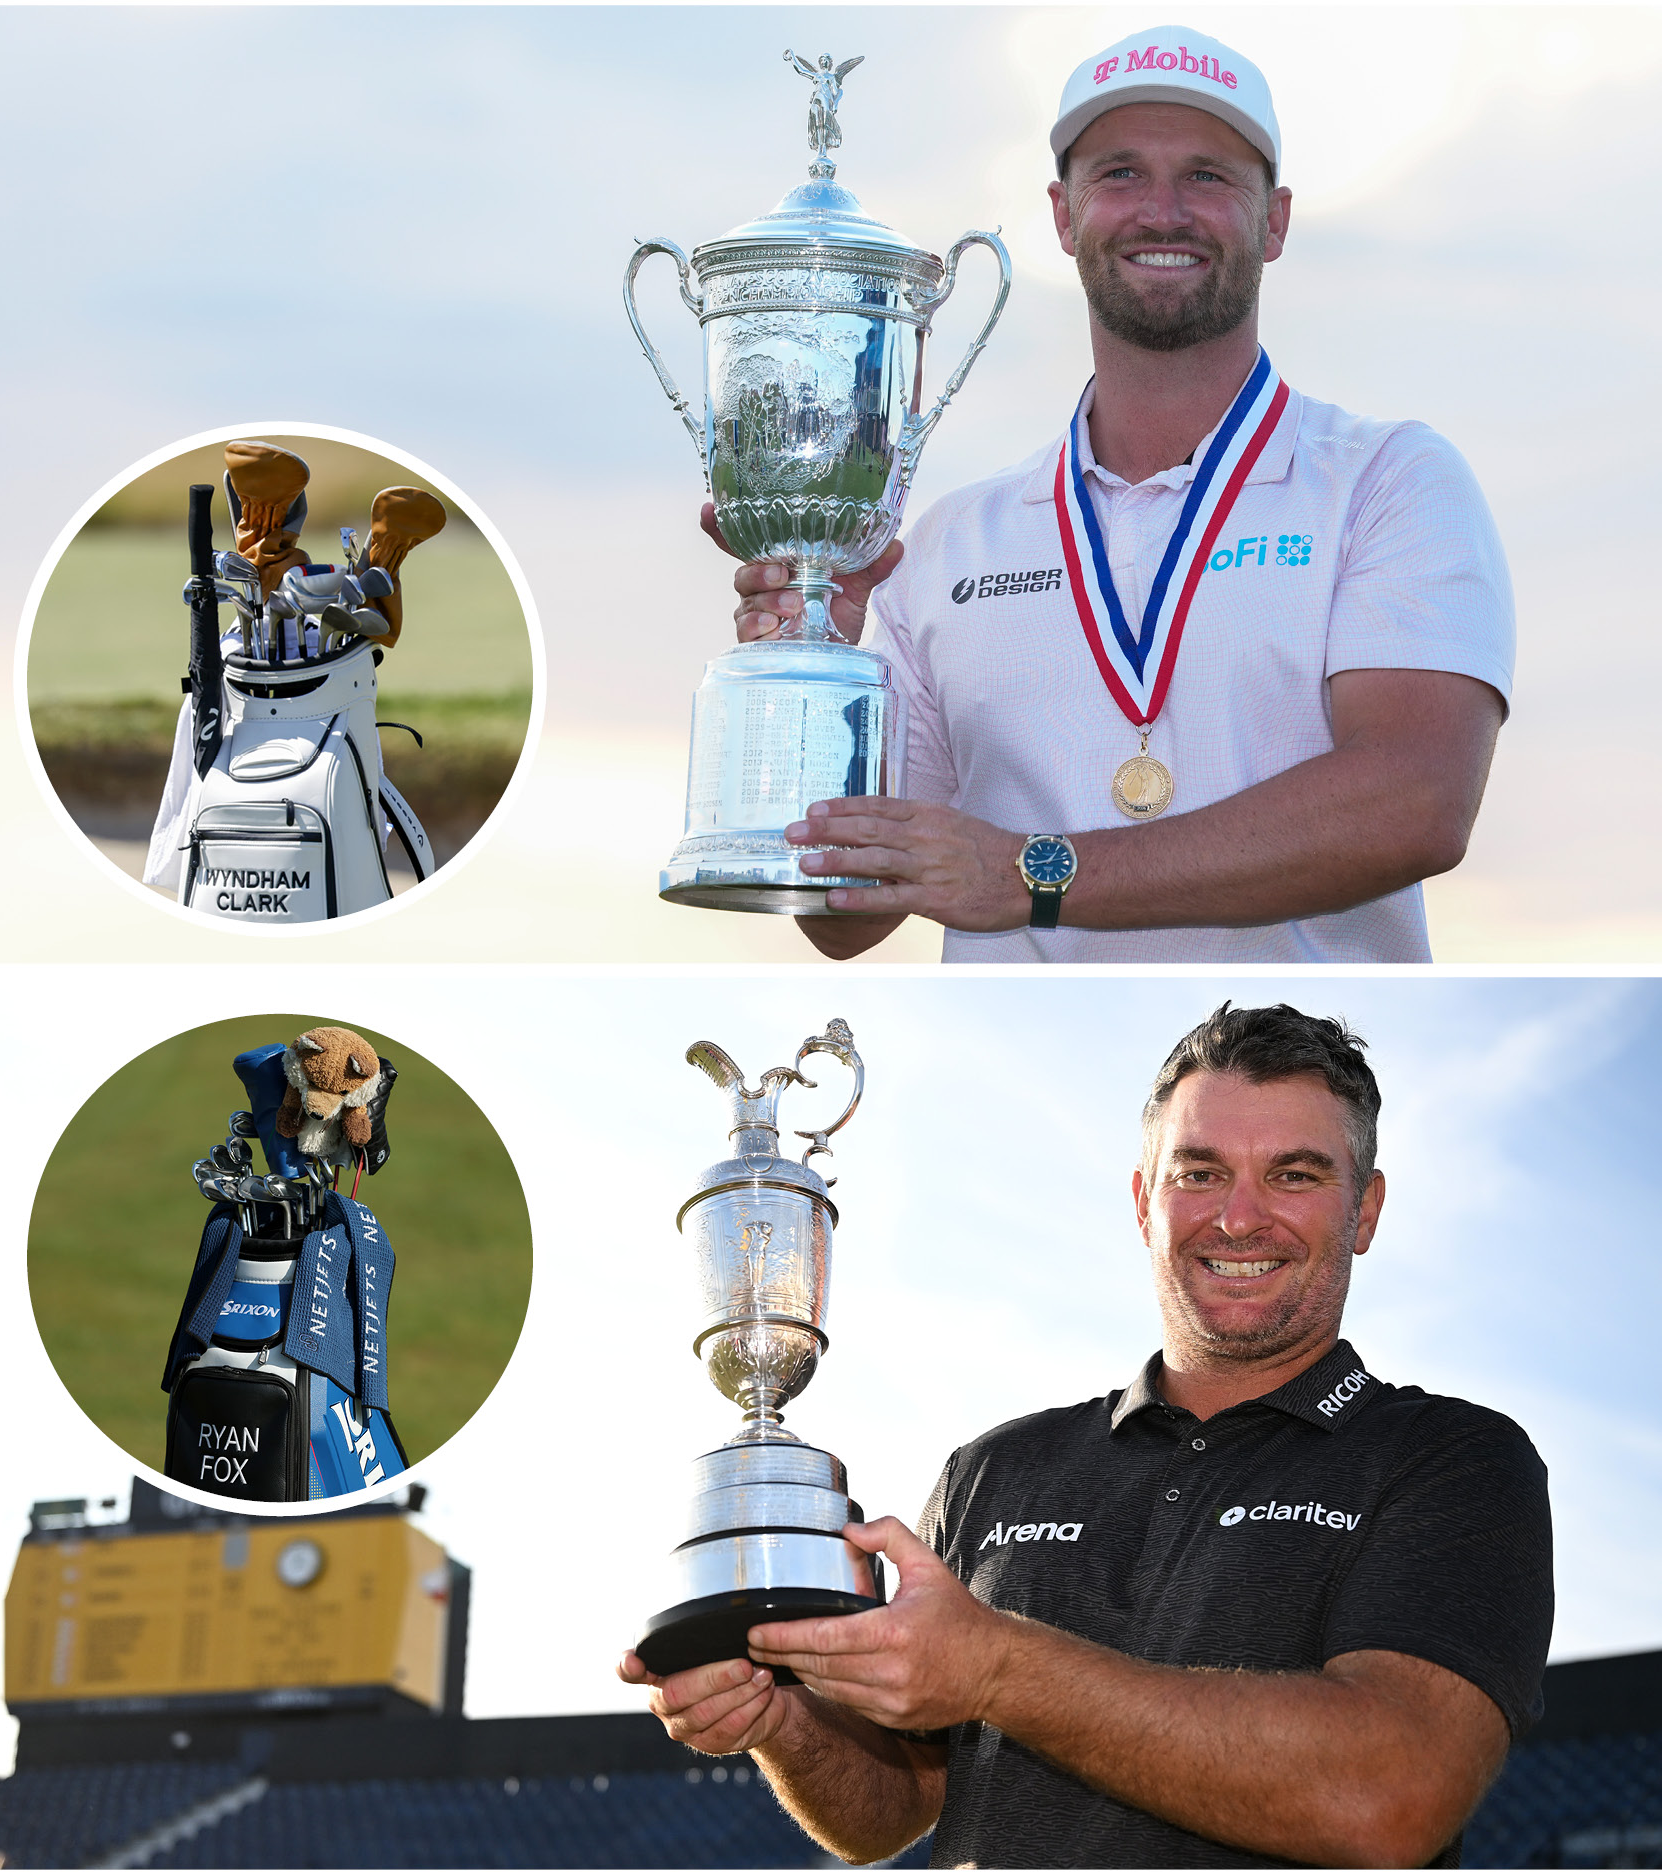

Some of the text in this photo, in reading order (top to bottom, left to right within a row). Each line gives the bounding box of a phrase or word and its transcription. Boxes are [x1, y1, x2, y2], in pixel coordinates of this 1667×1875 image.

[1124, 46, 1238, 90] Mobile
[1201, 535, 1268, 576] oFi
[206, 868, 311, 890] WYNDHAM
[217, 892, 288, 913] CLARK
[309, 1233, 337, 1338] NETJETS
[219, 1299, 281, 1318] SRIXON
[363, 1263, 381, 1374] NETJETS
[1316, 1367, 1370, 1419] RICOH
[198, 1422, 260, 1452] RYAN
[199, 1455, 249, 1485] FOX
[1248, 1501, 1363, 1533] claritev
[978, 1521, 1084, 1551] Arena
